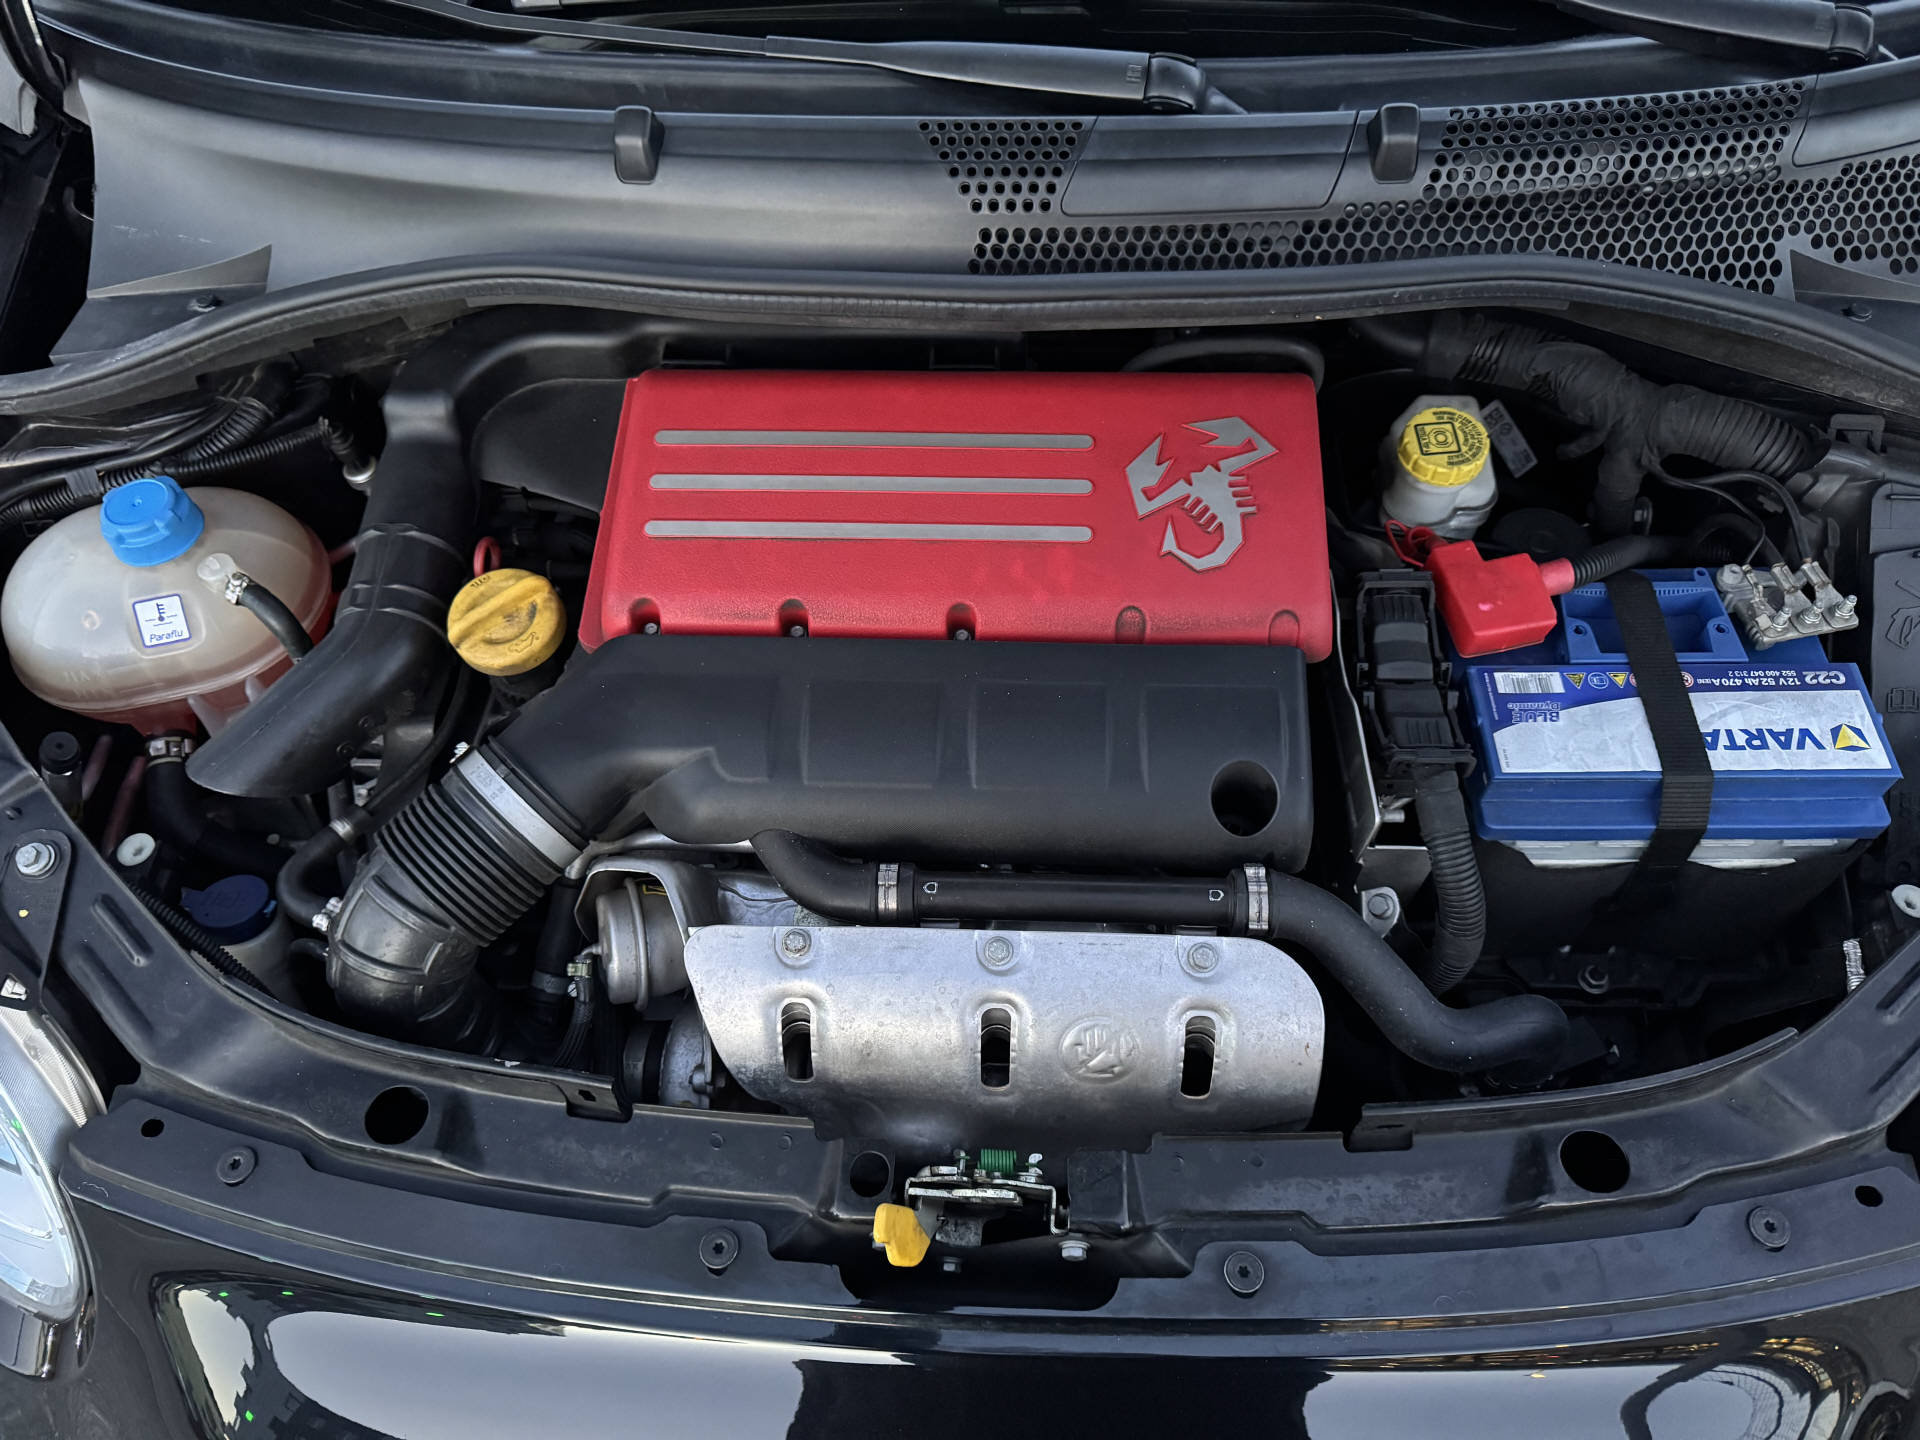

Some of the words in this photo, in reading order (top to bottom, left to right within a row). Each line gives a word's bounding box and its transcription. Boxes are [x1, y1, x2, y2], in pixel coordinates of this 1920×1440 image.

[150, 630, 184, 643] Paraflu
[1779, 677, 1801, 686] 12V
[1802, 671, 1846, 685] C22
[1507, 701, 1560, 710] Dynamic
[1511, 710, 1560, 723] BLUE
[1702, 728, 1827, 750] VARTA
